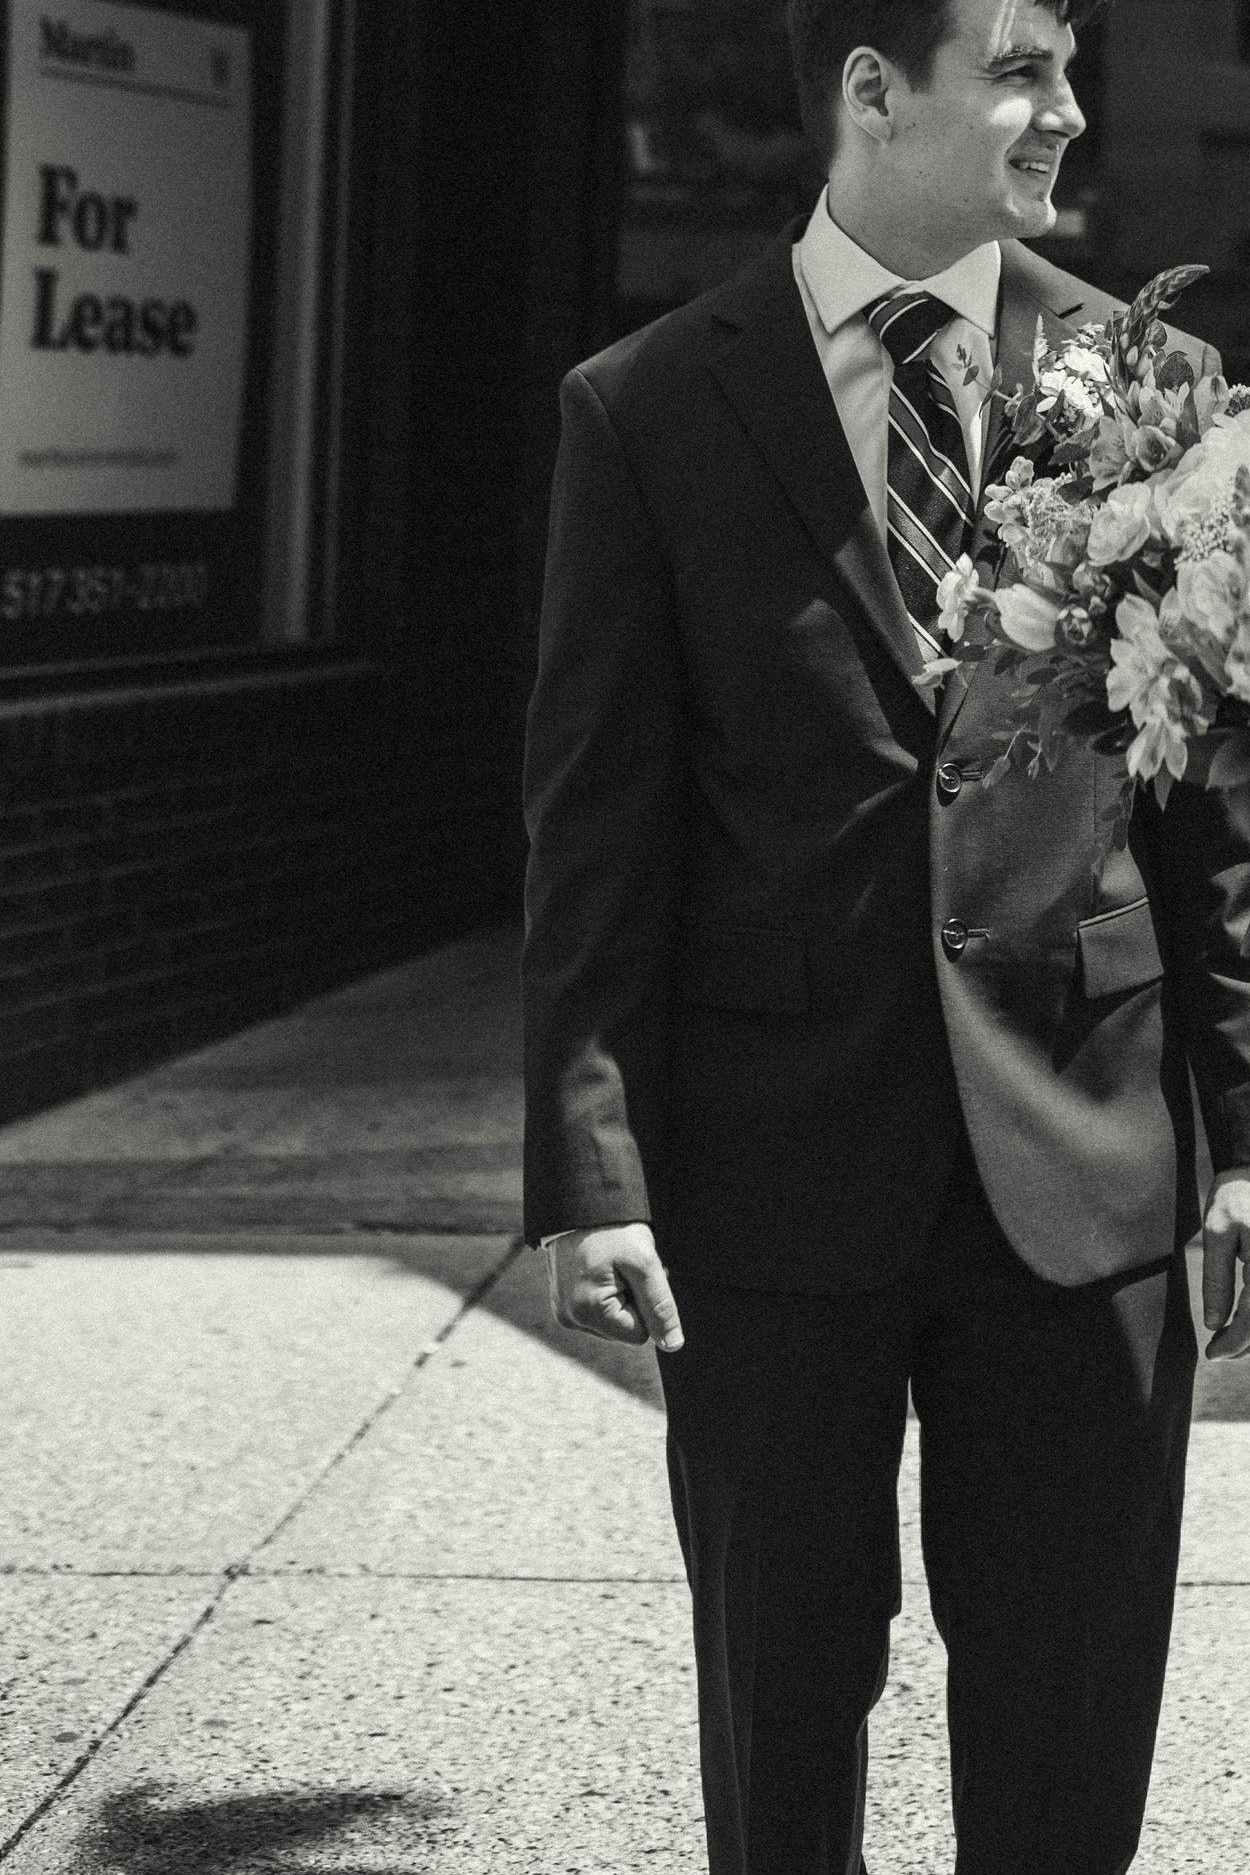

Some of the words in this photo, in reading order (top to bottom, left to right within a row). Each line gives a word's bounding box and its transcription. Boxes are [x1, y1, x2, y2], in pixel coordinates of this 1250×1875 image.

[38, 13, 137, 73] Martin
[36, 163, 139, 255] For
[30, 267, 200, 360] Lease
